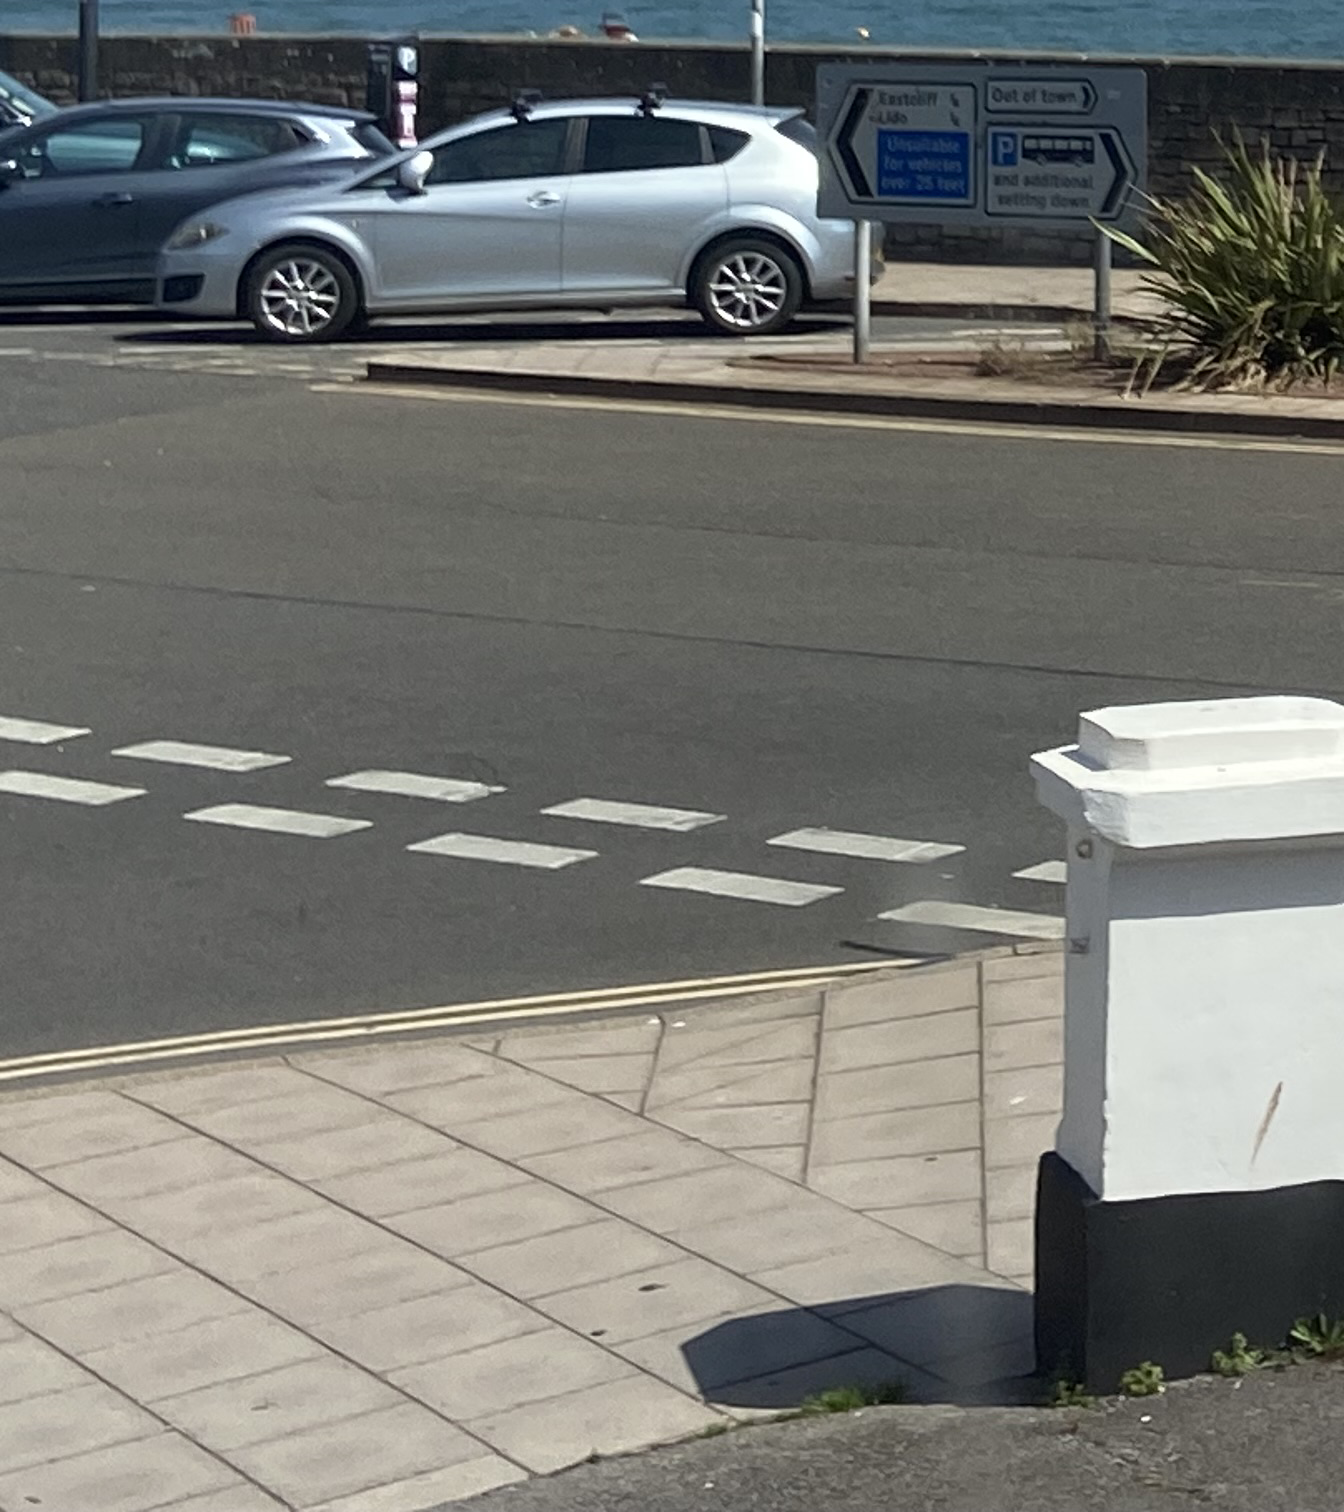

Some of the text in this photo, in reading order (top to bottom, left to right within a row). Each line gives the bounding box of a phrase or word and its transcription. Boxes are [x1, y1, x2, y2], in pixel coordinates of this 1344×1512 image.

[992, 87, 1077, 104] Out of town
[879, 111, 908, 125] Lido
[887, 136, 961, 153] Unsuitable
[996, 136, 1014, 164] P
[883, 155, 963, 173] for vehicles
[993, 174, 1094, 189] and additional
[997, 193, 1089, 209] setting down
